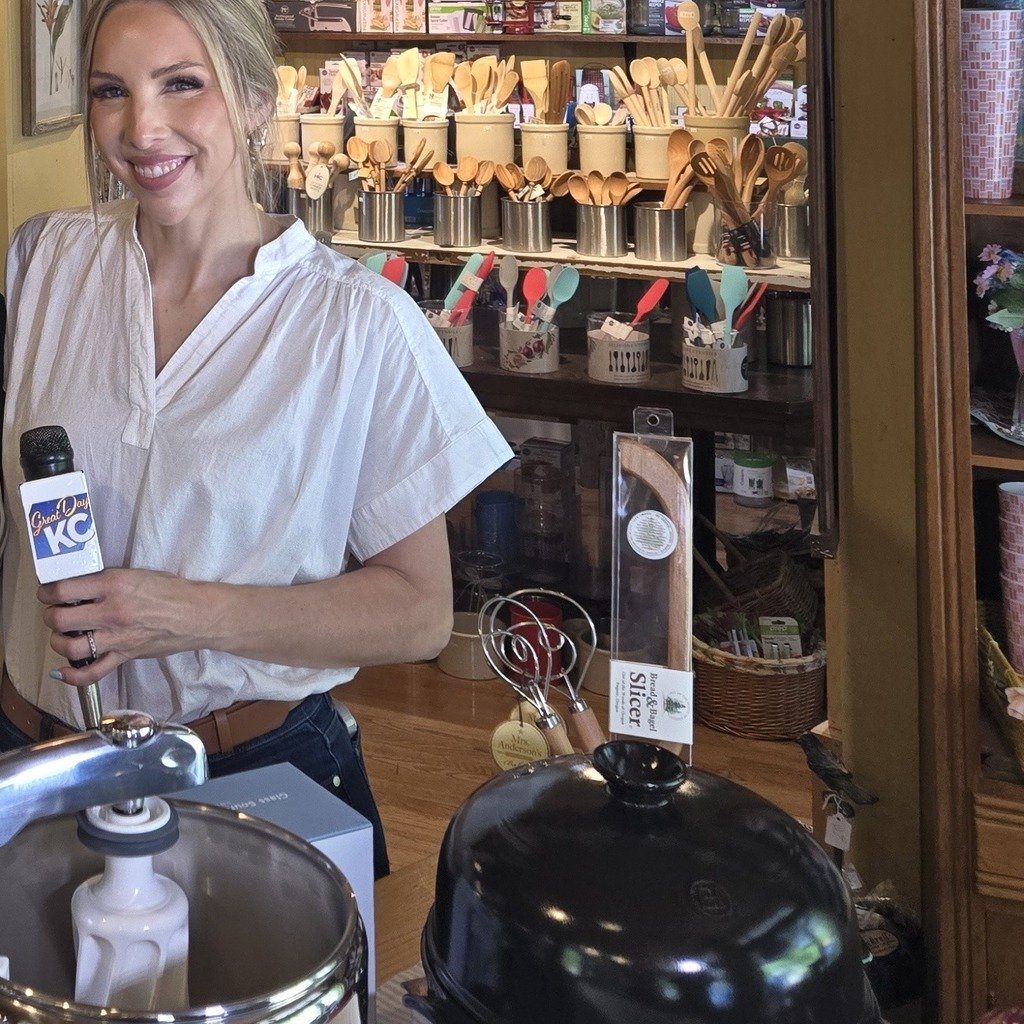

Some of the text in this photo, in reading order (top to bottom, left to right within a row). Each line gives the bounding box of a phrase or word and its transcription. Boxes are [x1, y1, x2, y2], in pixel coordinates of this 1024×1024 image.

[29, 494, 91, 537] Great Day
[43, 513, 95, 555] KC
[629, 672, 647, 728] Slicer
[646, 672, 658, 732] Bread & Bagel
[498, 740, 543, 757] Anderson's
